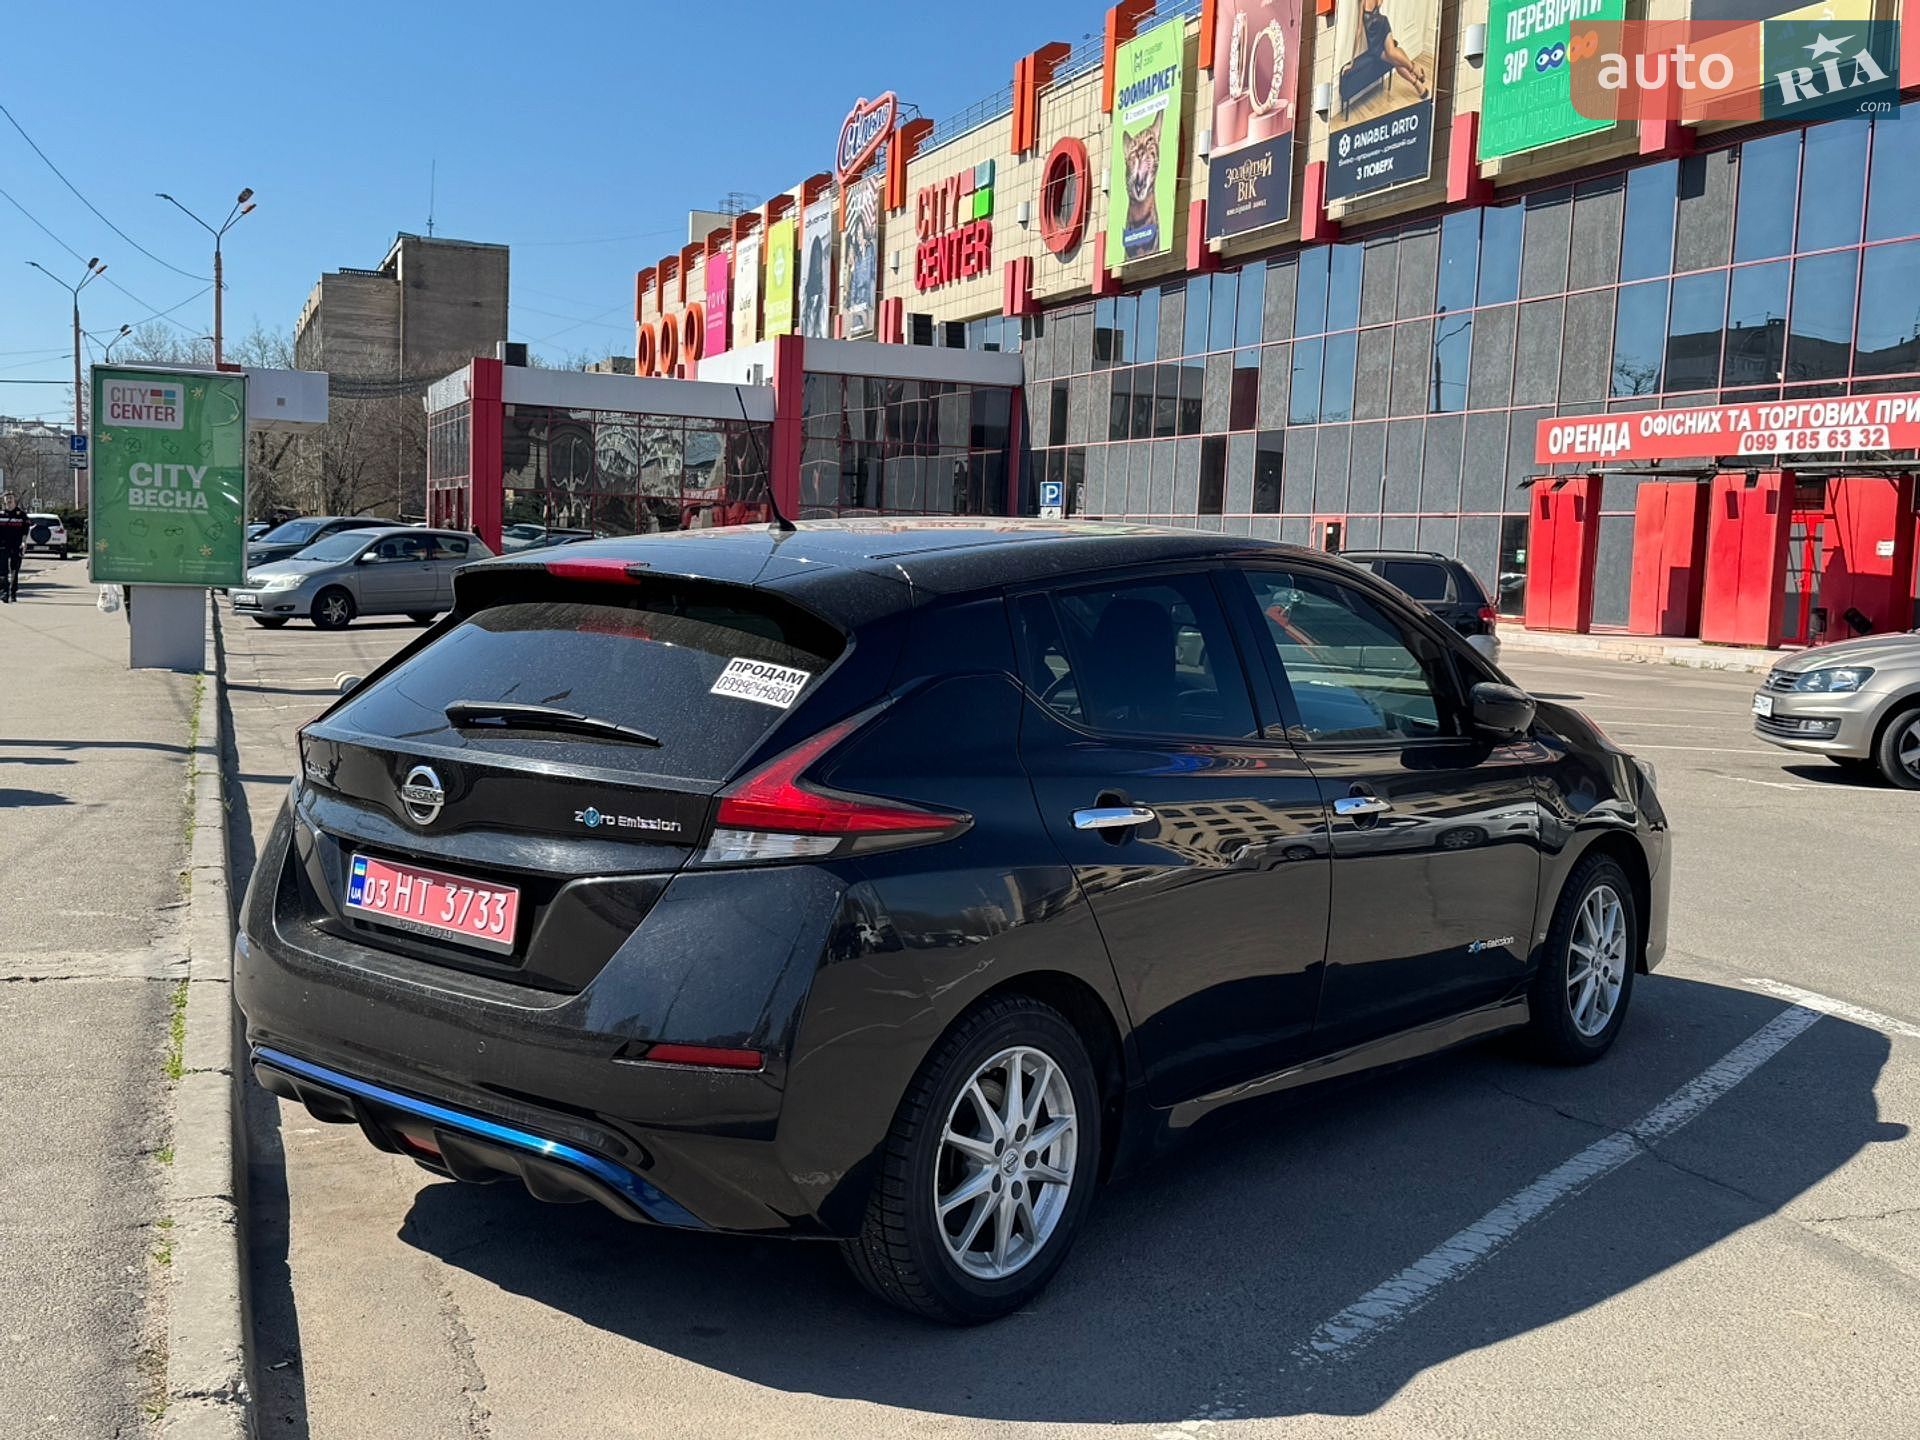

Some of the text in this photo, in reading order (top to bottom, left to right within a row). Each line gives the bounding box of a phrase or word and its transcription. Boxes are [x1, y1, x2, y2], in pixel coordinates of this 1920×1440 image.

[1502, 48, 1529, 86] ЗІР
[1117, 64, 1178, 110] ЗООМАРКЕТ
[1353, 114, 1419, 149] ANABEL ARTO
[1363, 156, 1394, 178] ПОВЕРХ
[1237, 176, 1258, 202] ВІК
[915, 172, 961, 240] CITY
[914, 220, 993, 291] CENTER
[110, 386, 149, 403] CITY
[110, 403, 176, 422] CENTER
[1548, 421, 1631, 458] ОРЕНДА
[1639, 410, 1723, 438] ОФІСНИХ
[1727, 409, 1752, 432] ТА
[1757, 400, 1869, 430] ТОРГОВИХ
[1743, 427, 1884, 452] 099 185 63 32
[128, 462, 208, 489] CITY
[128, 487, 209, 509] ВЕСНА
[729, 661, 806, 685] ПРОДАМ
[350, 886, 362, 900] UA
[365, 877, 391, 909] 03
[393, 872, 434, 916] HT
[440, 884, 510, 934] 3733
